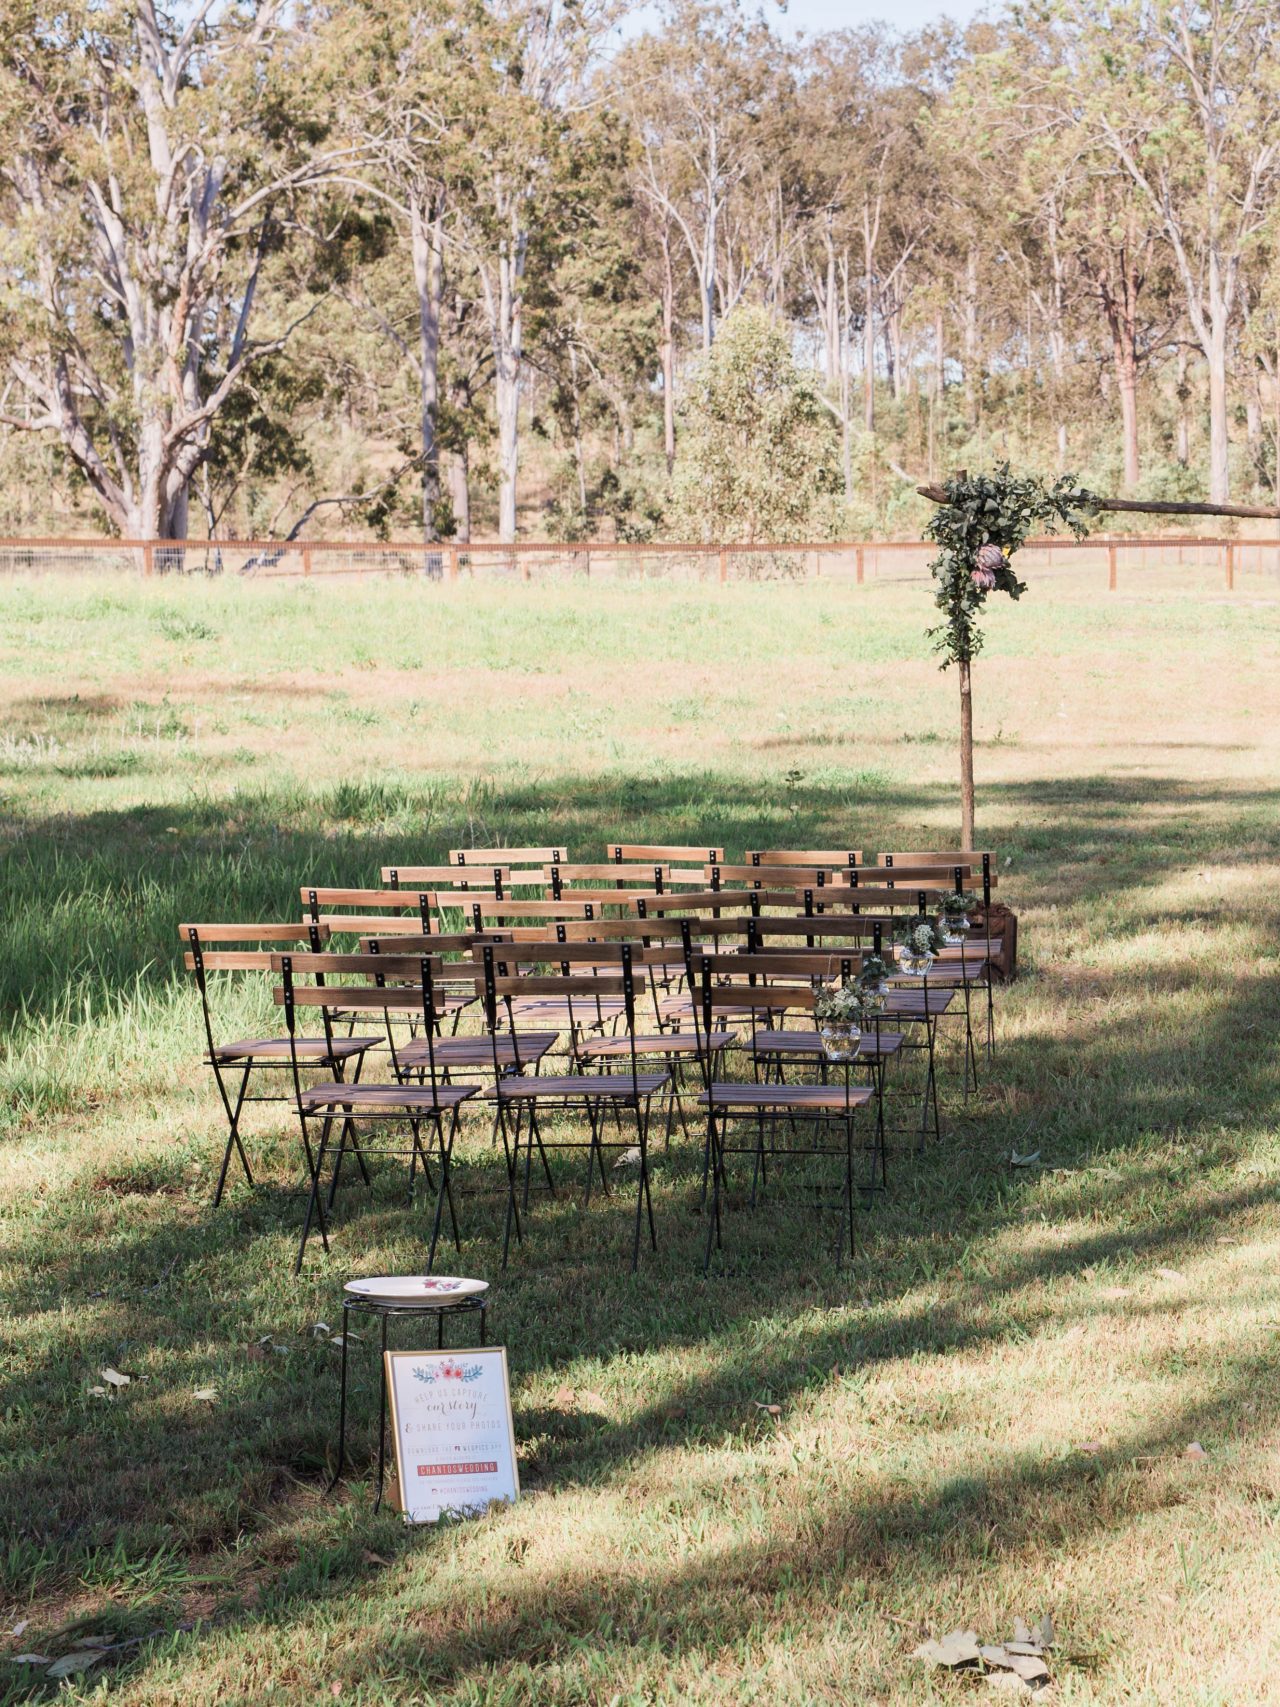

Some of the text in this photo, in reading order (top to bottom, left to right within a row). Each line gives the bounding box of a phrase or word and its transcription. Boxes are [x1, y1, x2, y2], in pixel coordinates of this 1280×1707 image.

[452, 1388, 487, 1402] CAPTURE
[416, 1422, 442, 1432] SHARE
[446, 1421, 466, 1431] YOUR
[471, 1419, 502, 1430] PHOTOS
